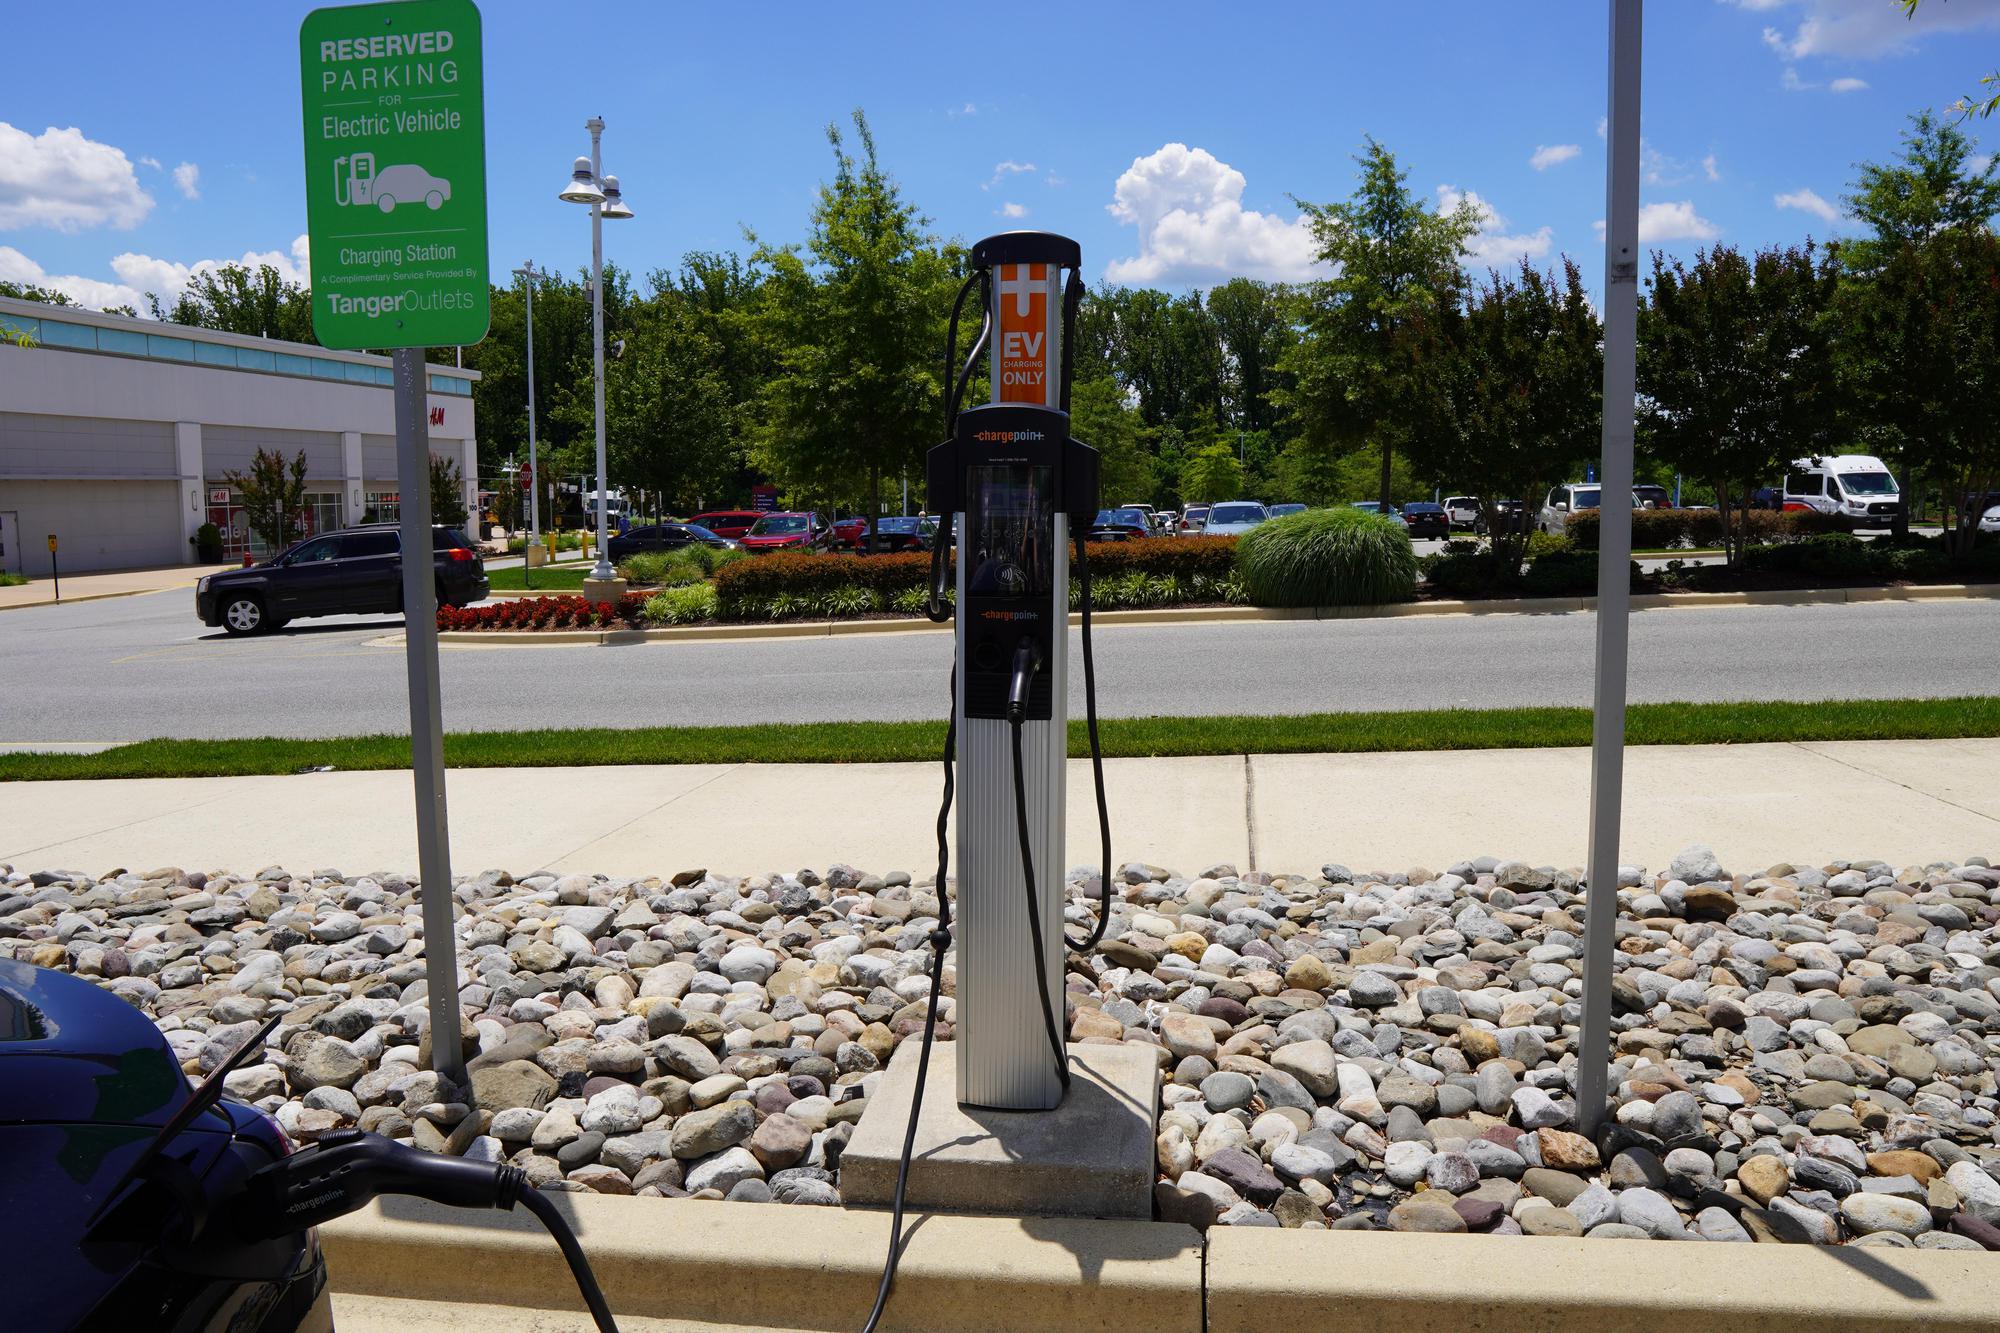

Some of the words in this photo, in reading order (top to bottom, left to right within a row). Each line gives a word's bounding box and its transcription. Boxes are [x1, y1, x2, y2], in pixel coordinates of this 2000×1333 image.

[321, 31, 454, 62] RESERVED
[323, 61, 458, 92] PARKING
[379, 95, 402, 106] FOR
[323, 113, 389, 139] Electric
[395, 107, 461, 134] Vehicle
[340, 246, 402, 267] Charging
[407, 243, 456, 262] Station
[321, 276, 327, 284] A
[329, 273, 391, 284] Complimentary
[393, 272, 424, 281] Service
[426, 268, 464, 278] Provided
[466, 268, 477, 279] By
[1003, 332, 1044, 358] EV
[1003, 372, 1044, 385] ONLY
